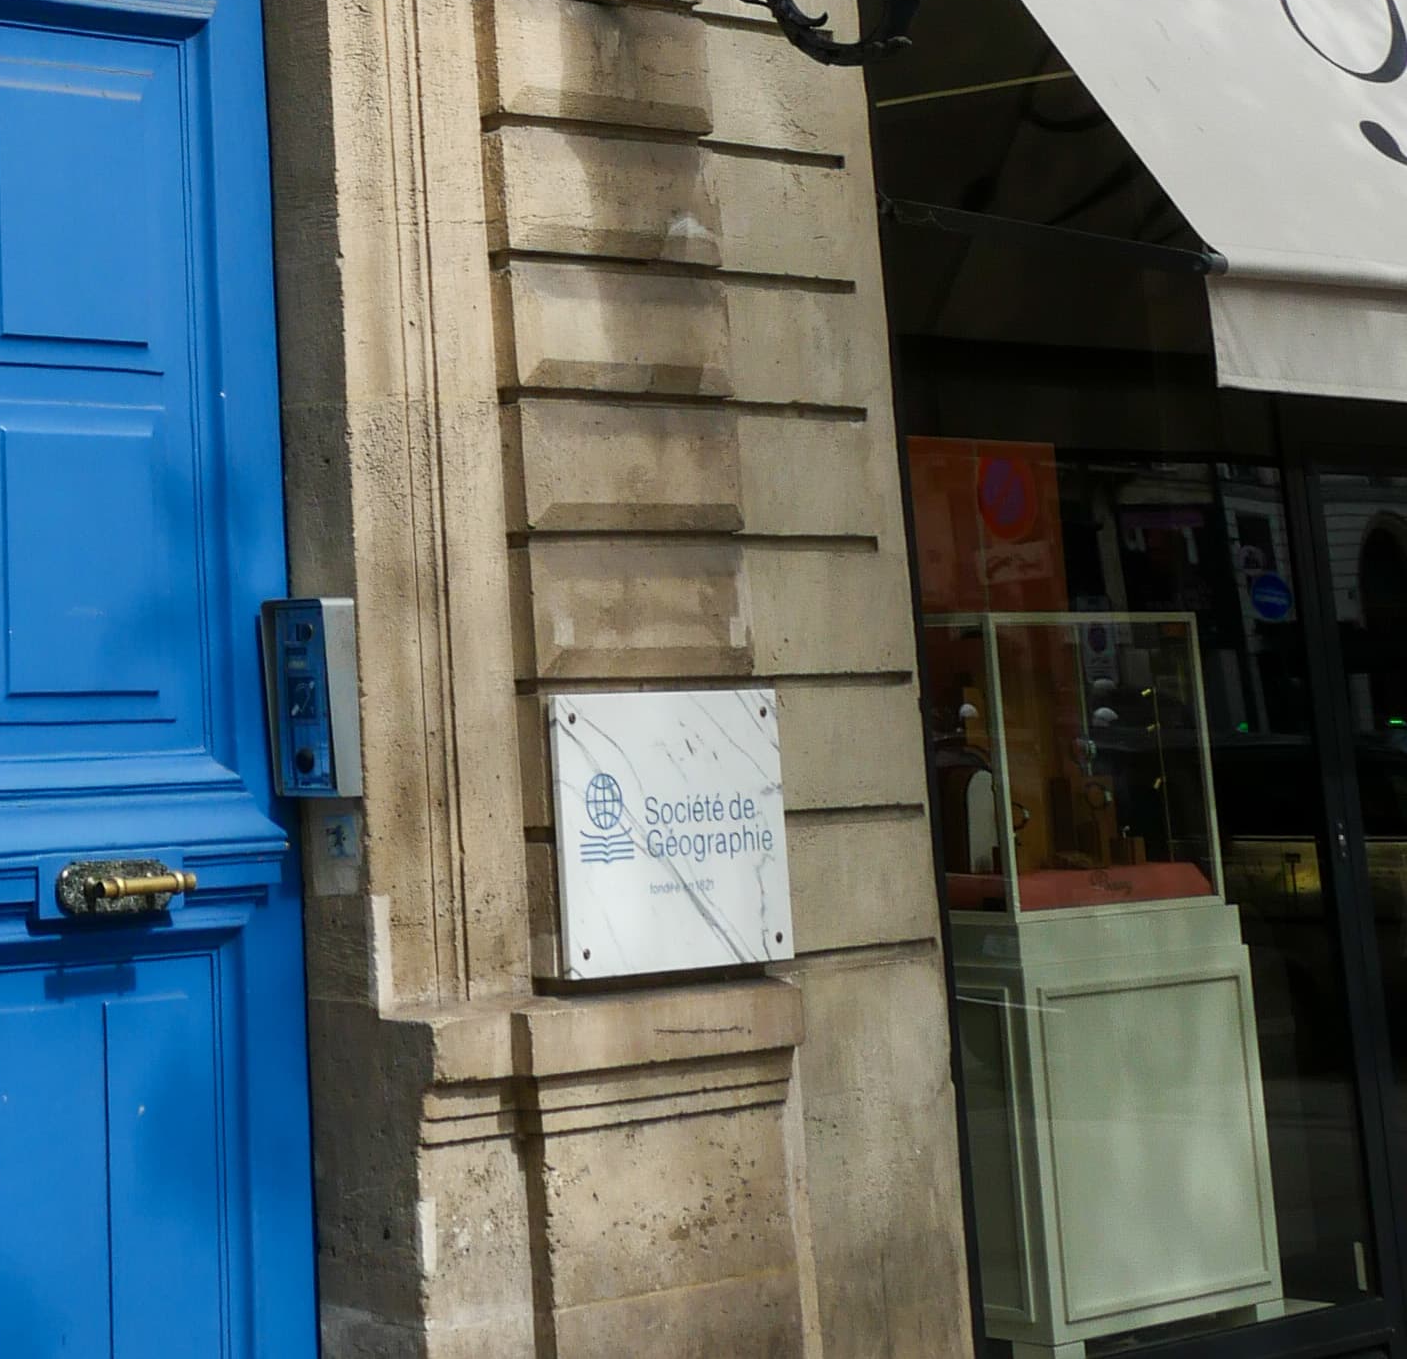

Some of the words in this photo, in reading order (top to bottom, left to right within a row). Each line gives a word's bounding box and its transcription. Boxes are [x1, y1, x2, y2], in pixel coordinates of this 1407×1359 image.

[644, 792, 725, 826] Société
[729, 791, 757, 821] de
[647, 823, 774, 863] Géographie
